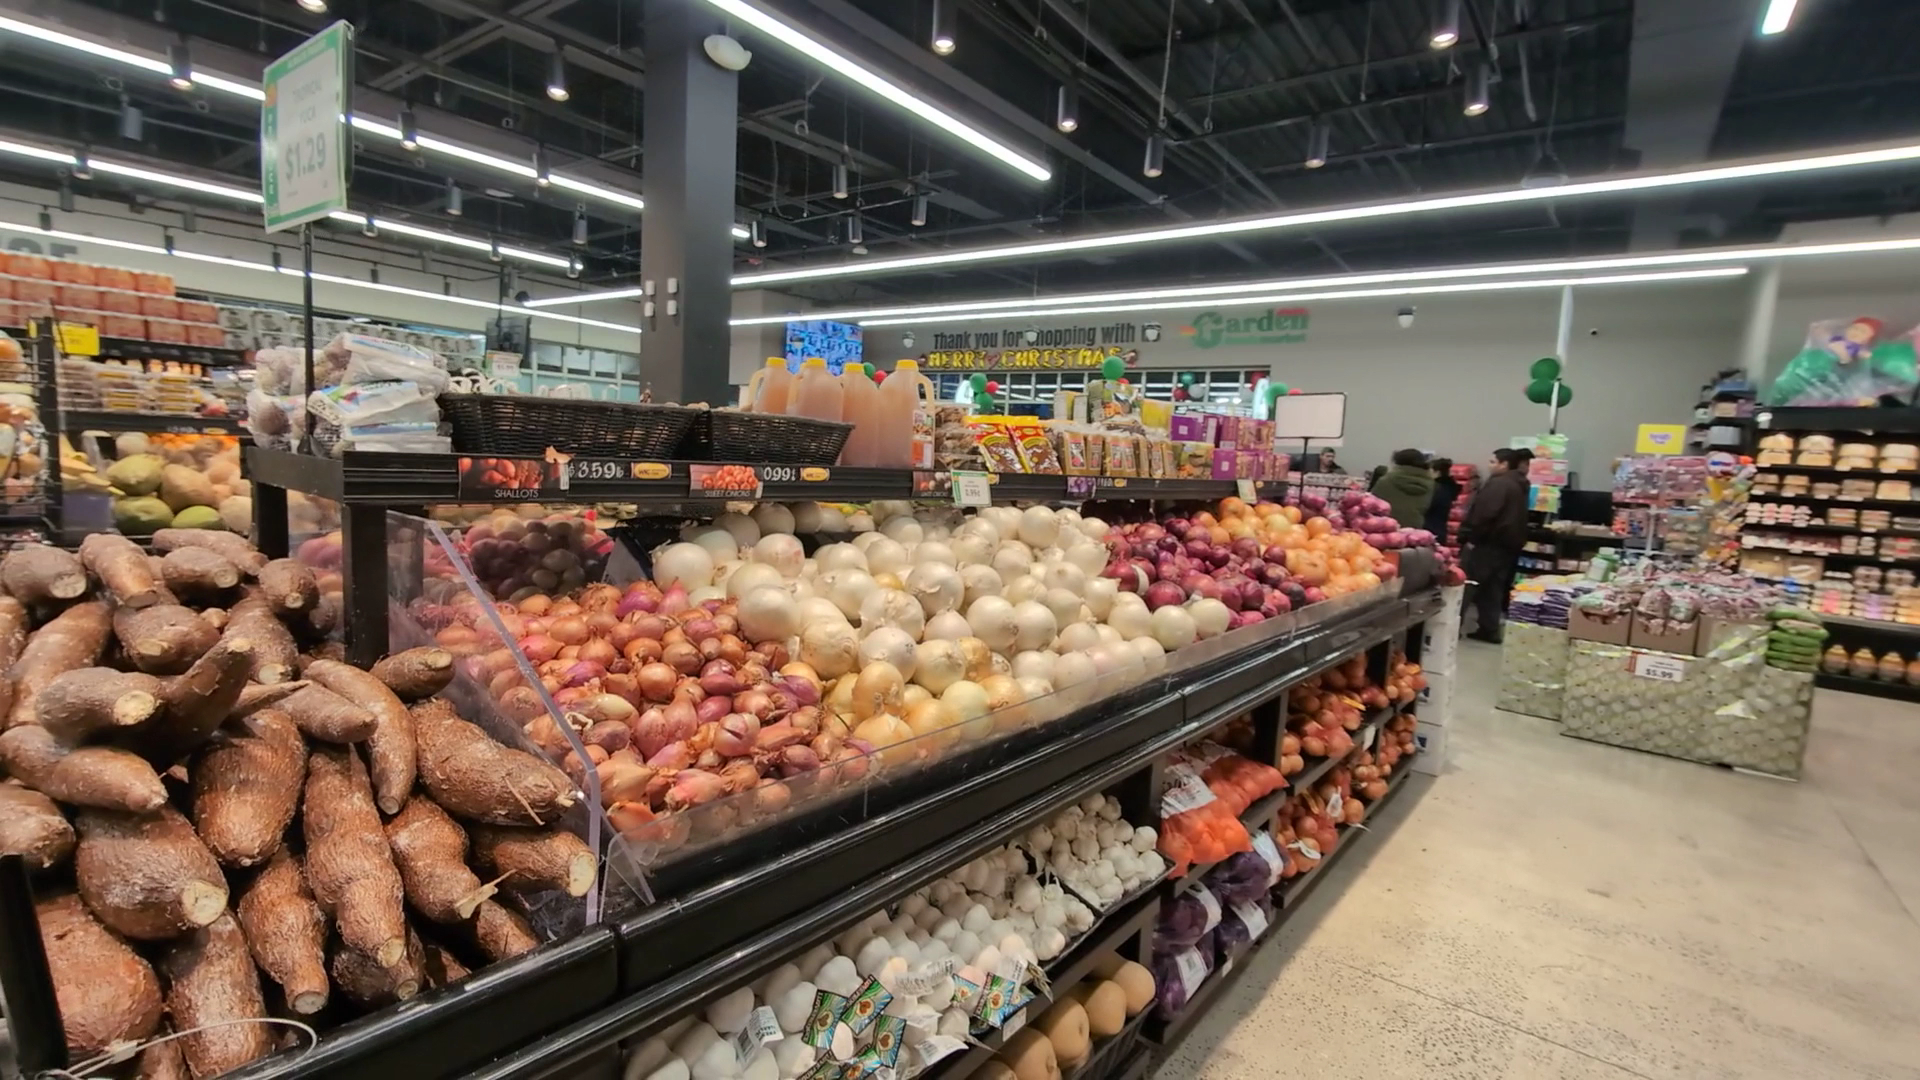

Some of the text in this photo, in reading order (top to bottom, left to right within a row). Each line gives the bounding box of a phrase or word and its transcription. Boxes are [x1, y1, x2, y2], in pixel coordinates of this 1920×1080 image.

[286, 132, 326, 184] $1.29
[934, 332, 971, 349] Thank
[975, 332, 998, 350] you
[1002, 329, 1024, 347] for
[1101, 323, 1136, 343] with
[928, 350, 985, 369] MERRY
[494, 488, 539, 498] SHALLOTS
